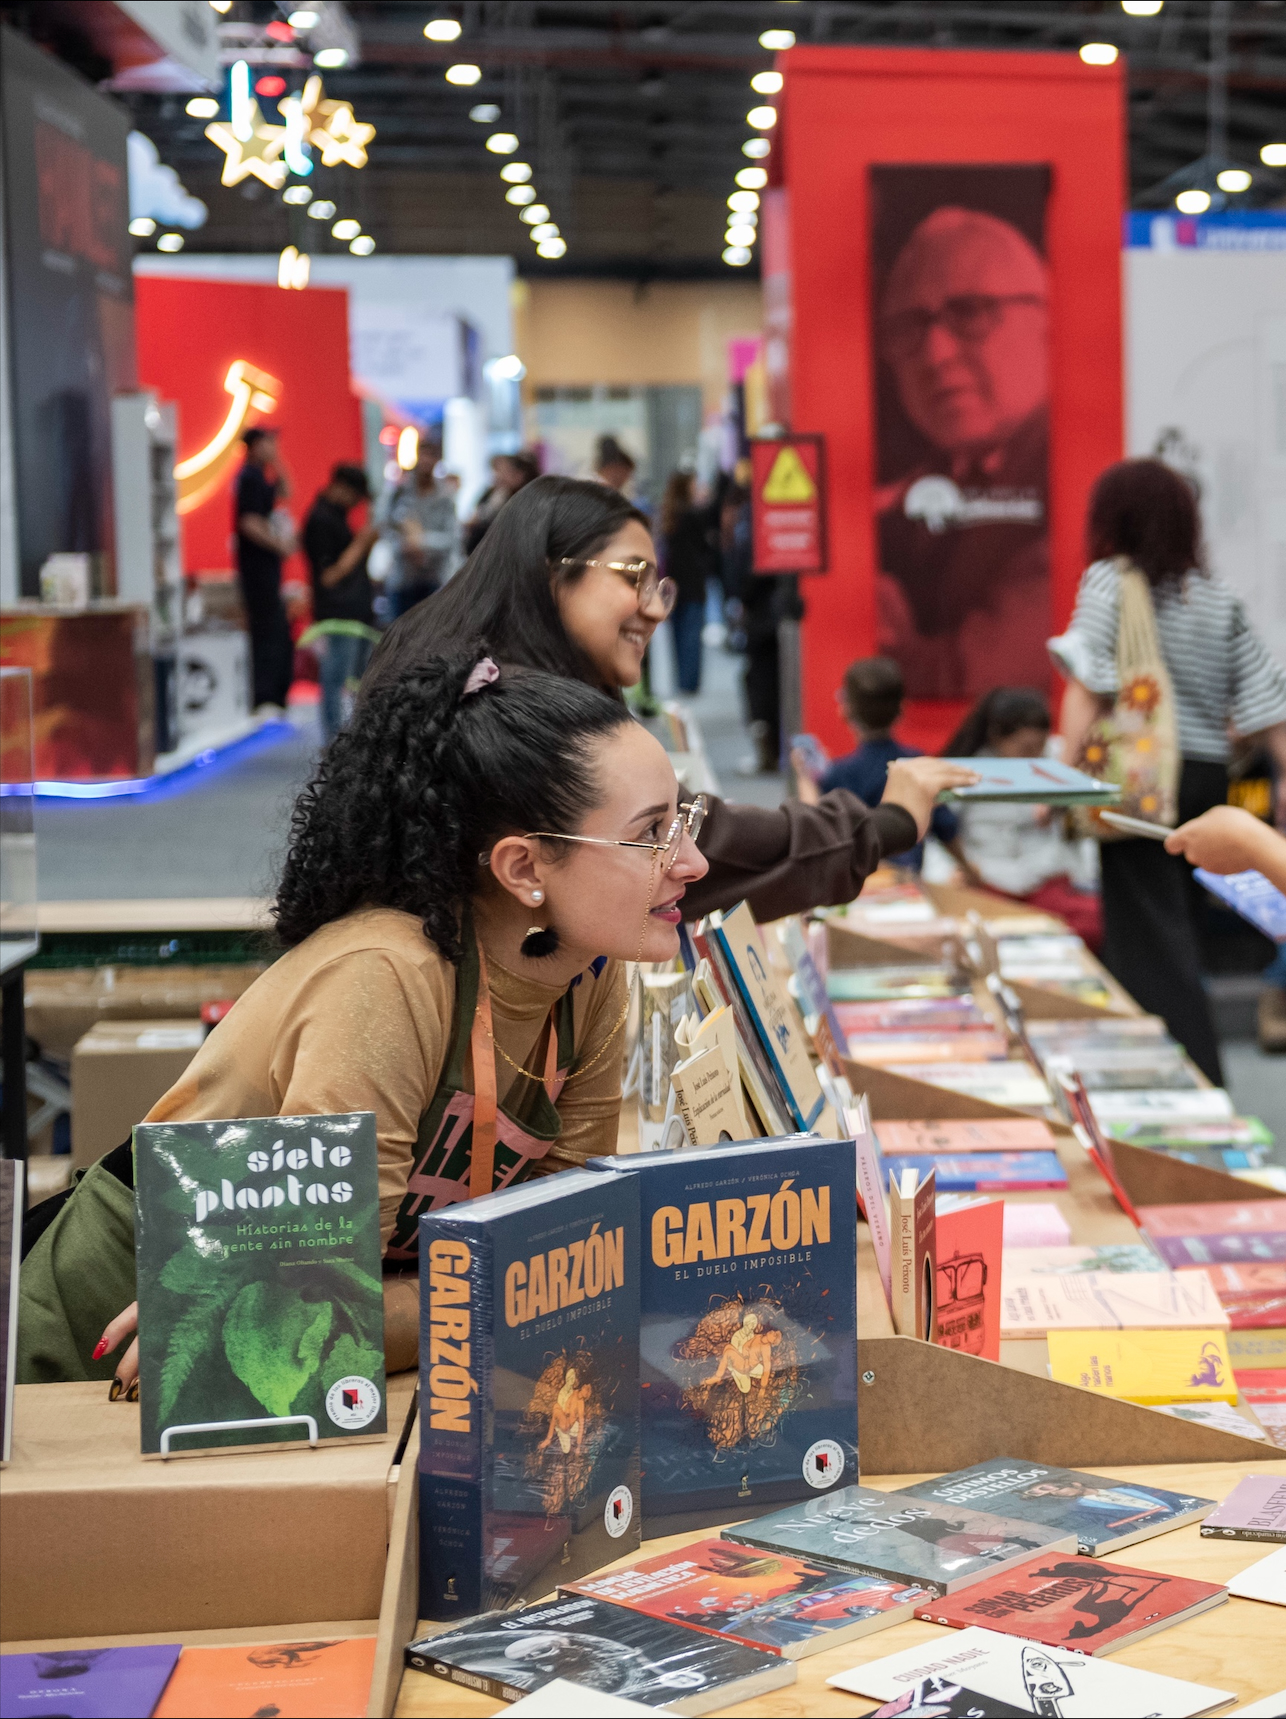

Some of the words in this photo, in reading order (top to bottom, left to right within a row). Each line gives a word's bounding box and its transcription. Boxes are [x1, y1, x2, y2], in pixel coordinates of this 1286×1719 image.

[675, 1089, 687, 1107] José
[688, 1127, 698, 1146] Peixo
[247, 1136, 352, 1173] siete
[195, 1174, 354, 1223] plantas
[684, 1181, 713, 1191] ALFREDO
[715, 1177, 740, 1187] GARZÓN
[747, 1172, 779, 1183] VERÓNICA
[780, 1170, 800, 1179] OCHOA
[860, 1156, 872, 1192] PÁJAROS
[872, 1214, 884, 1247] VERANO
[236, 1220, 308, 1237] Historias
[314, 1217, 332, 1231] de
[339, 1215, 354, 1229] la
[651, 1178, 831, 1269] GARZÓN
[901, 1214, 911, 1233] José
[221, 1240, 263, 1258] gente
[269, 1238, 292, 1250] sin
[299, 1234, 354, 1247] nombre
[505, 1222, 624, 1328] GARZÓN
[675, 1269, 690, 1281] EL
[697, 1263, 738, 1278] DUELO
[744, 1251, 812, 1270] IMPOSIBLE
[902, 1258, 913, 1294] Peixoto
[428, 1239, 479, 1433] GARZÓN
[520, 1329, 531, 1341] EL
[535, 1314, 563, 1336] DUELO
[566, 1297, 612, 1323] IMPOSIBLE
[931, 1469, 1019, 1497] ÚLTIMOS
[945, 1469, 1049, 1504] DESTELLOS
[773, 1497, 885, 1534] Nueve
[830, 1507, 933, 1544] dedos
[593, 1586, 620, 1596] DE
[615, 1560, 698, 1589] LEVITACIÓN
[1006, 1578, 1093, 1612] PERROS
[500, 1620, 524, 1630] EL
[516, 1599, 599, 1625] INSTALADOR
[963, 1591, 1030, 1615] SOÑAR
[892, 1662, 949, 1683] CIUDAD
[942, 1647, 990, 1665] NADIE
